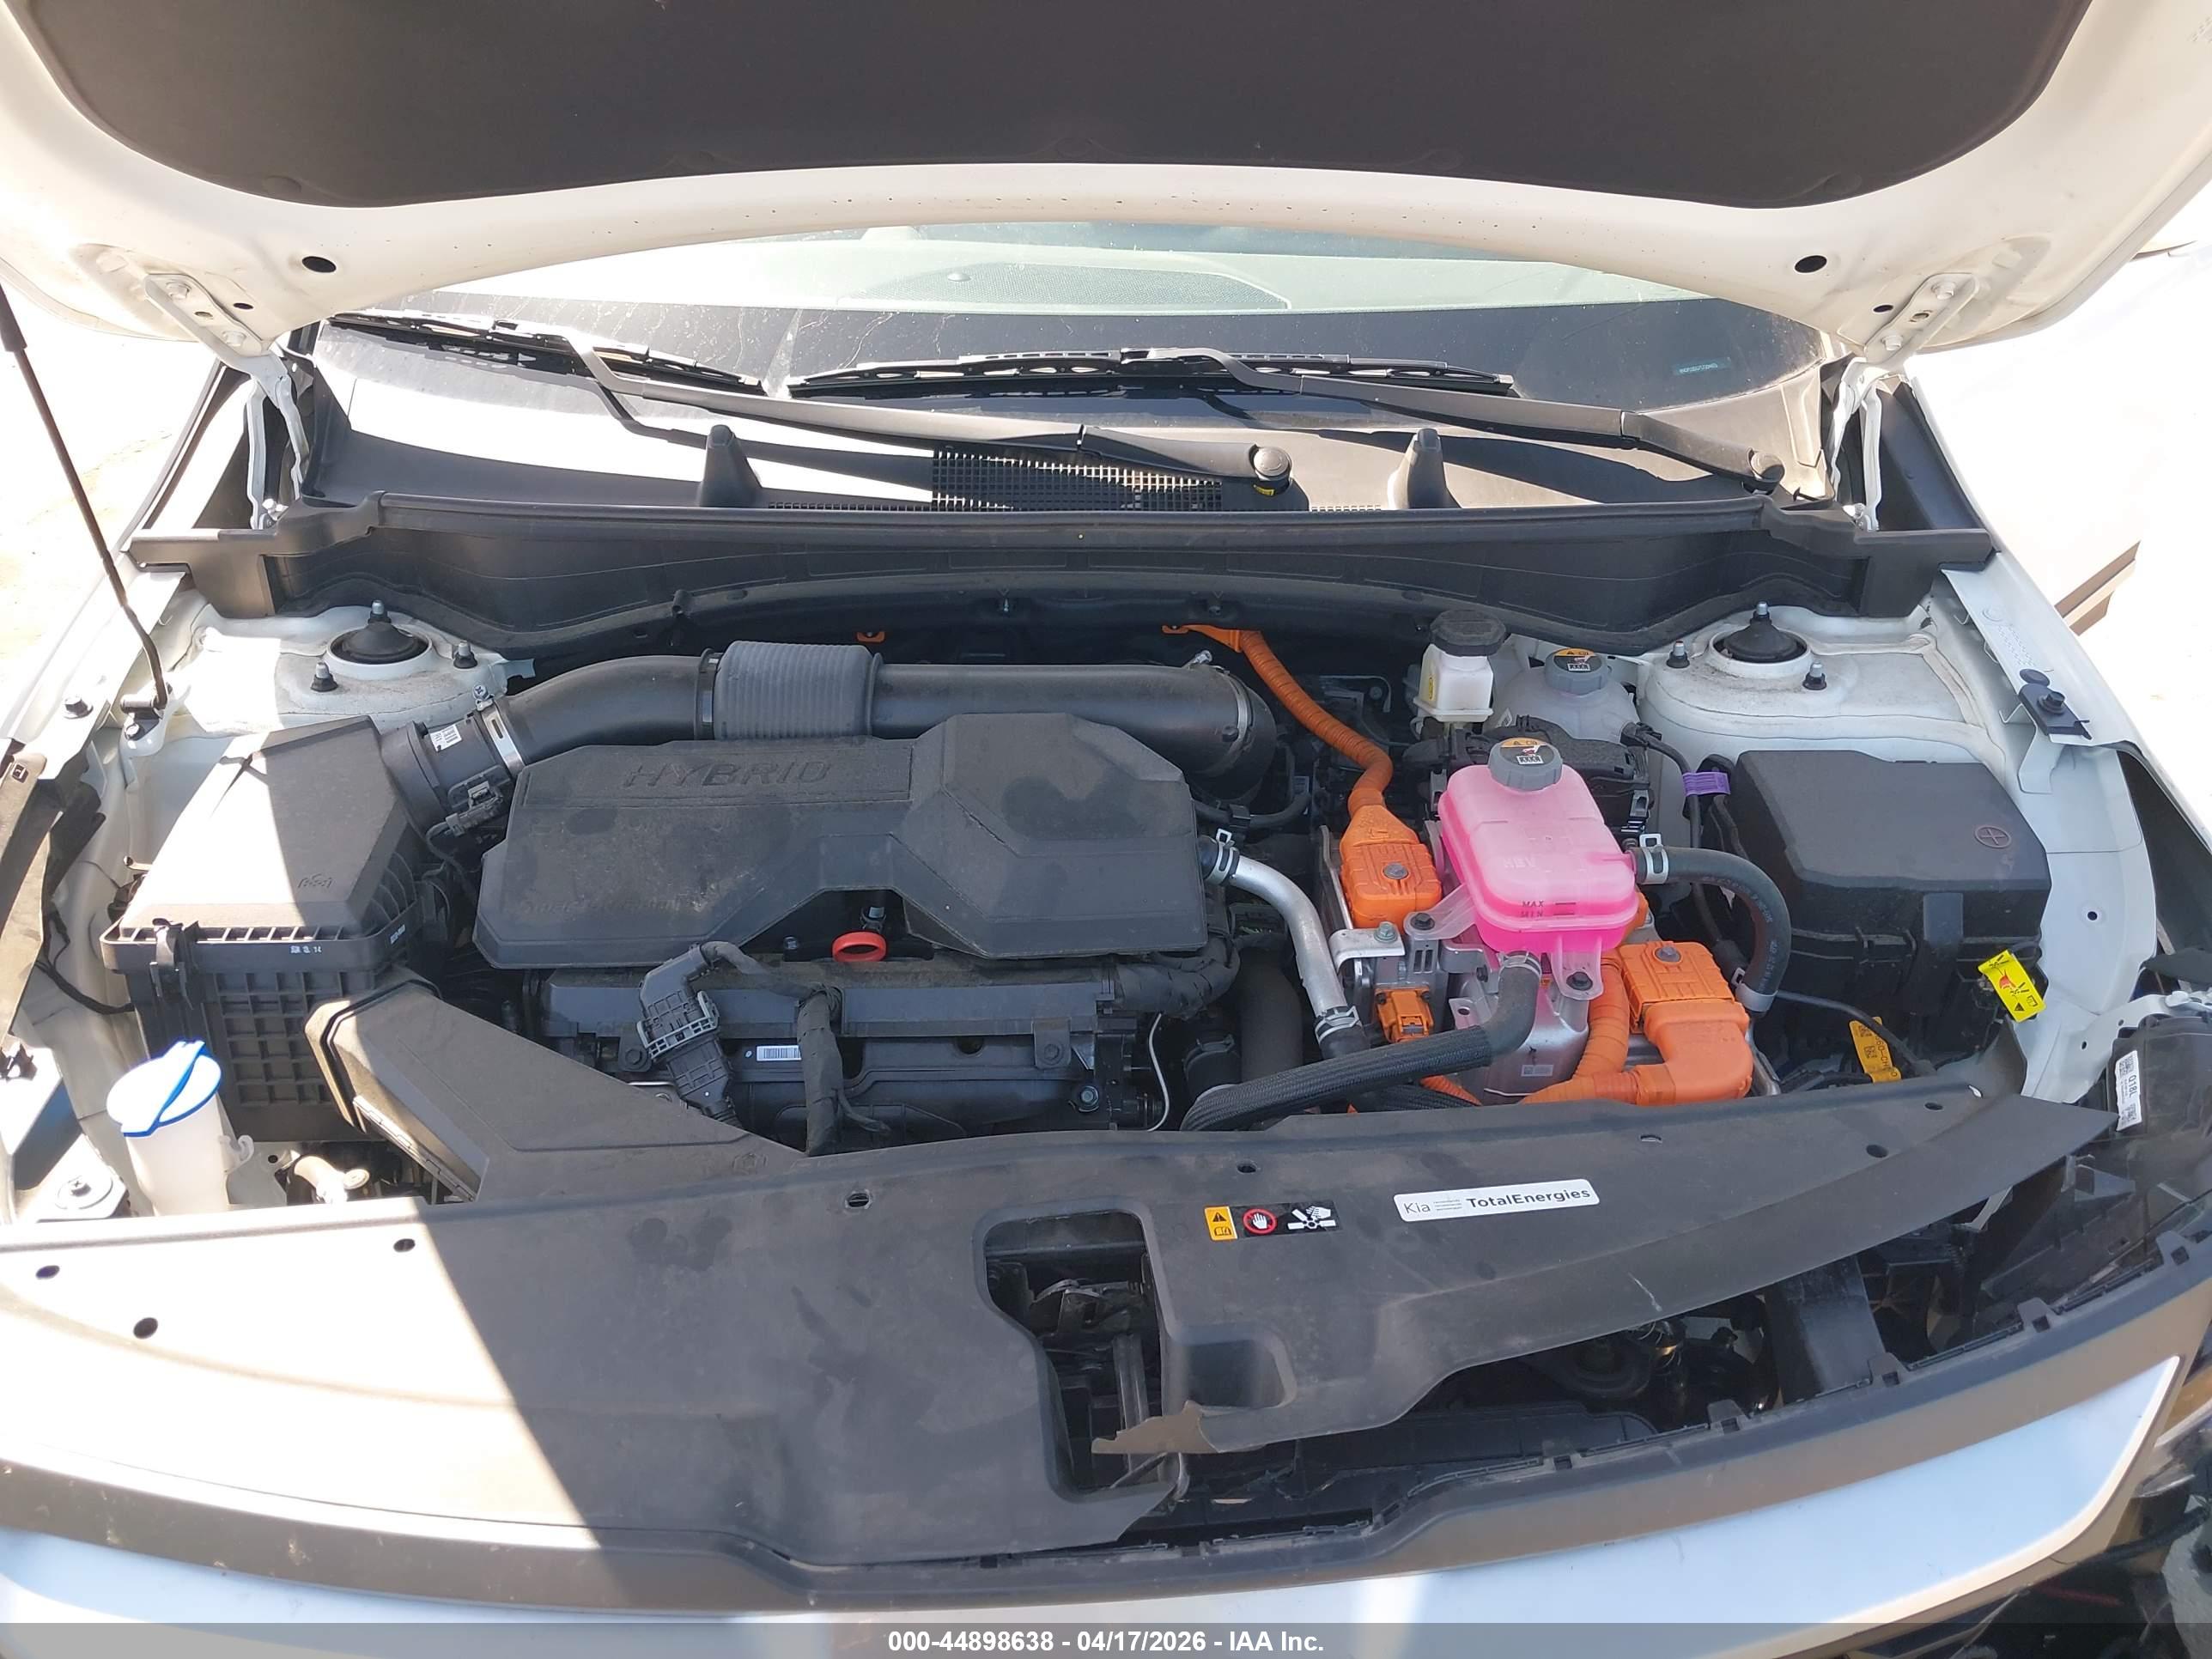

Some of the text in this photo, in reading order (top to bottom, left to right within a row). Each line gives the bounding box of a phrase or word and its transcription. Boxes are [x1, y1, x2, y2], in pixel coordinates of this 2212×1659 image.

[623, 761, 832, 787] HYBRID
[2128, 1075, 2139, 1098] Q18L
[1404, 1201, 1431, 1214] Kia
[1466, 1188, 1590, 1209] TotalEnergies
